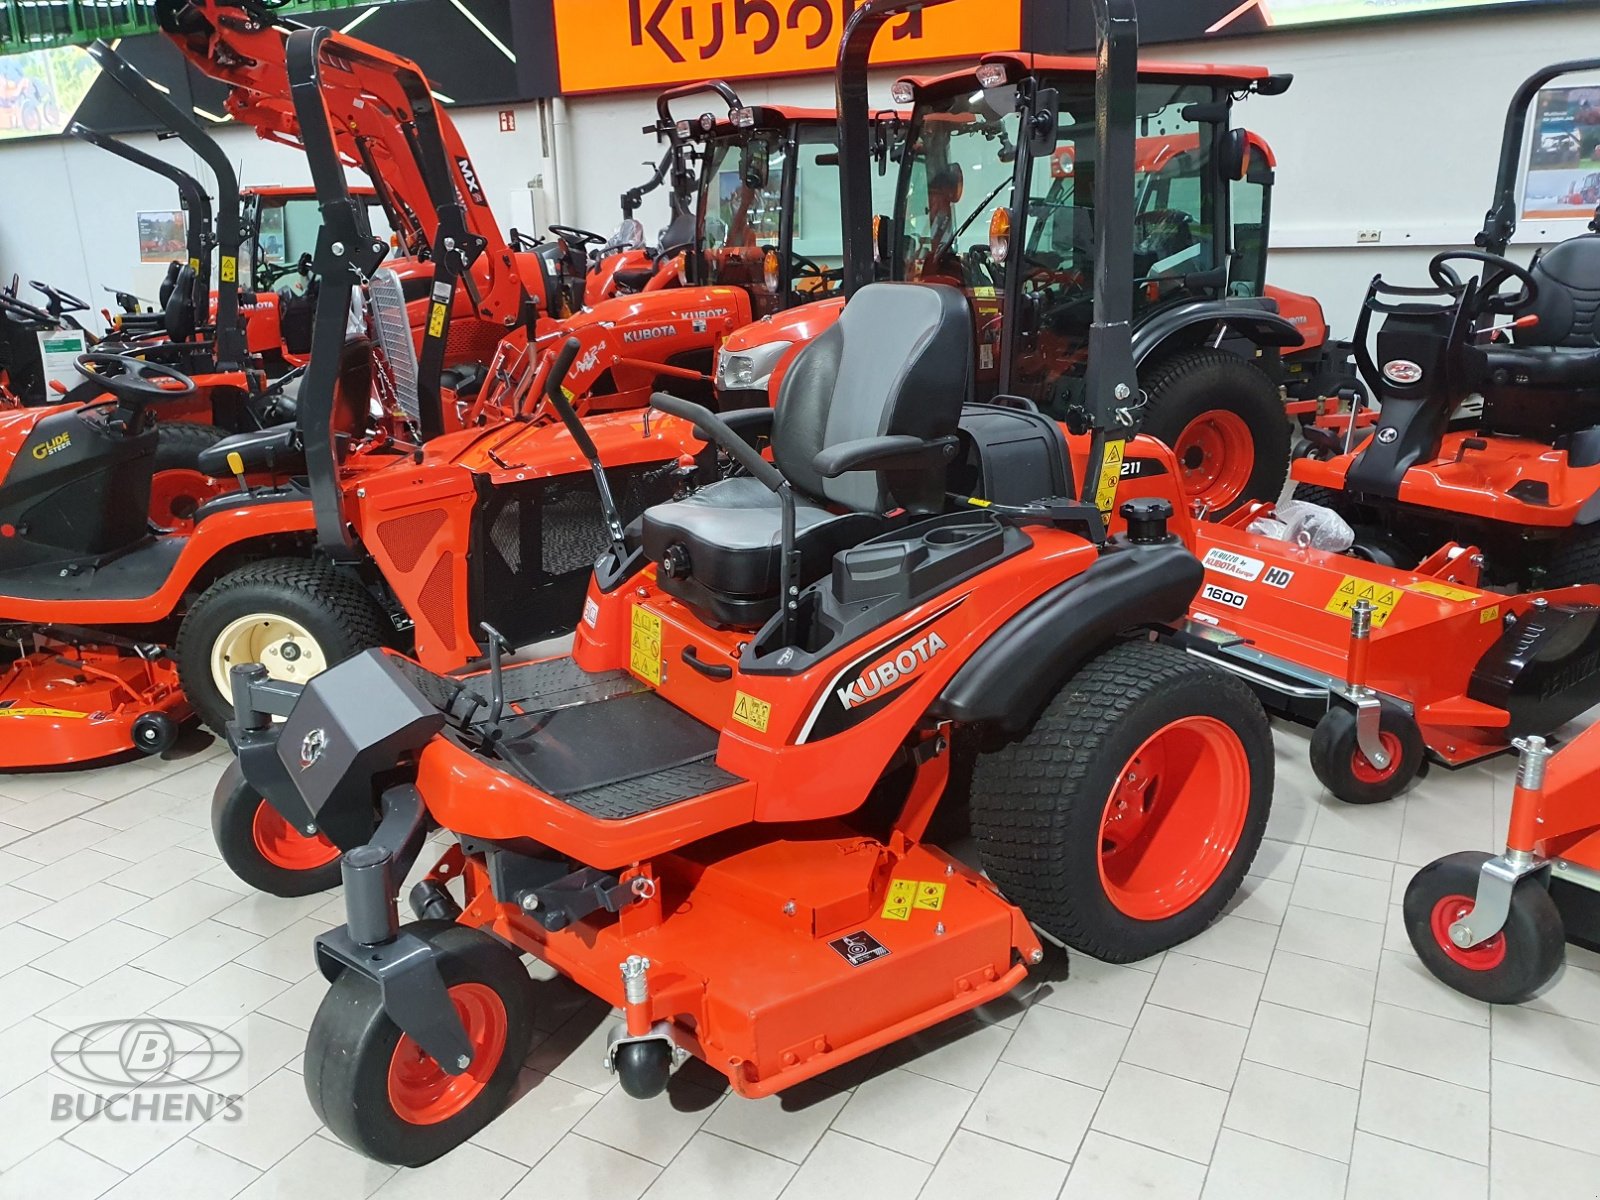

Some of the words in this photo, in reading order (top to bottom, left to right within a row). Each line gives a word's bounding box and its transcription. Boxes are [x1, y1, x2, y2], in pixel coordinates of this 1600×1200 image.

[458, 160, 479, 193] MX
[623, 325, 677, 343] KUBOTA
[32, 431, 70, 460] GLIDE
[48, 440, 72, 456] STEER
[1204, 557, 1236, 573] KUBOTA
[1209, 550, 1239, 563] PERUZZO
[1264, 568, 1290, 586] HD
[1207, 587, 1245, 607] 1600
[836, 631, 948, 711] KUBOTA
